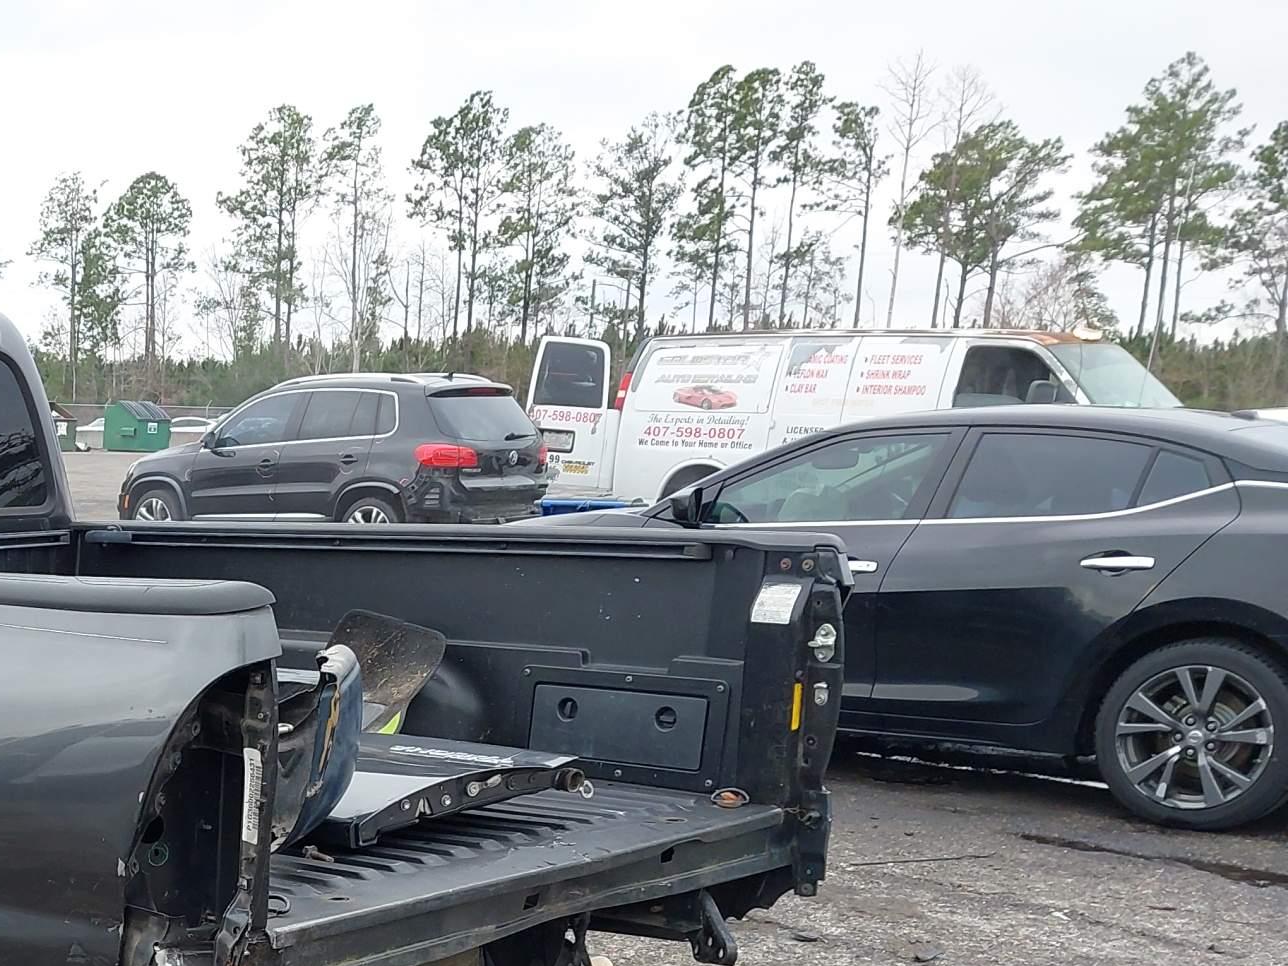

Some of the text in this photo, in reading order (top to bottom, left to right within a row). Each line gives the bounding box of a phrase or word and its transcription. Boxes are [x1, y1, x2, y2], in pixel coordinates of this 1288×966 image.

[870, 354, 924, 365] FLEET SERVICES
[865, 369, 912, 380] SHRINK WRAP
[790, 383, 804, 393] CLAY
[862, 384, 927, 396] INTERIOR SHAMPOO
[528, 407, 602, 424] 407-598-0807
[648, 413, 663, 424] The
[664, 413, 694, 426] Experts
[706, 415, 750, 428] Detailing!
[643, 426, 746, 439] 407-598-0807
[650, 439, 670, 447] Come
[681, 440, 697, 448] Your
[698, 440, 719, 448] Home
[730, 441, 753, 450] Office
